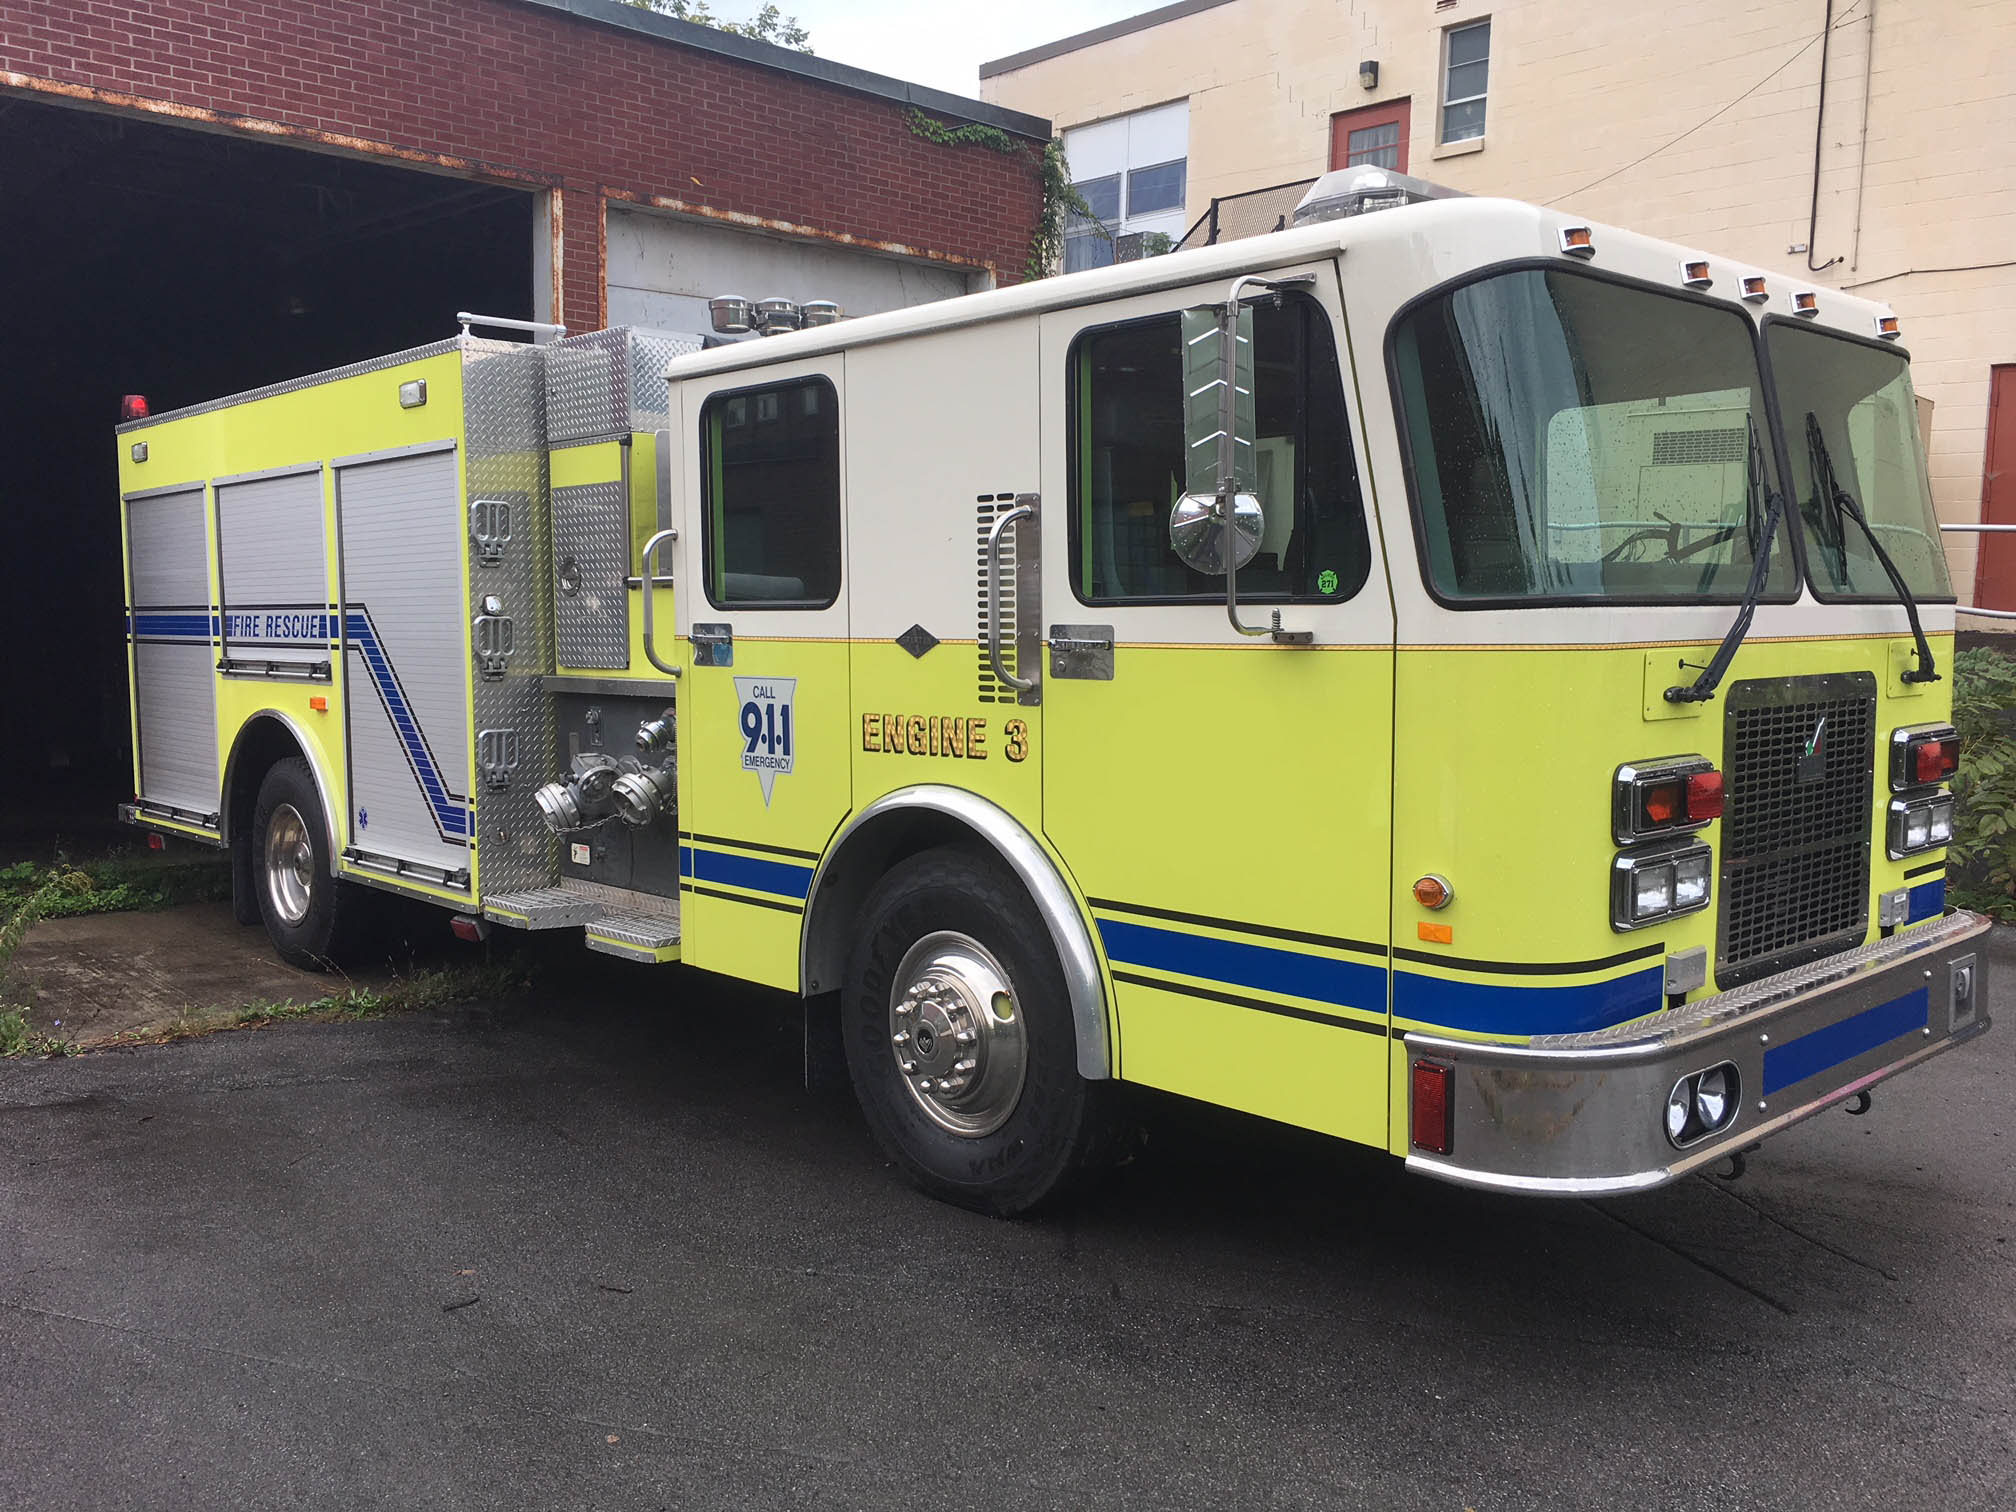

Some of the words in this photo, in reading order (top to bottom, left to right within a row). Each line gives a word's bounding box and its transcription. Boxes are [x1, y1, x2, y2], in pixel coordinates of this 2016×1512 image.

[1321, 580, 1334, 588] 271
[233, 615, 260, 637] FIRE
[266, 614, 318, 638] RESCUE
[753, 685, 776, 699] CALL
[862, 713, 987, 760] ENGINE
[1005, 719, 1029, 763] 3
[744, 754, 790, 770] EMERGENCY
